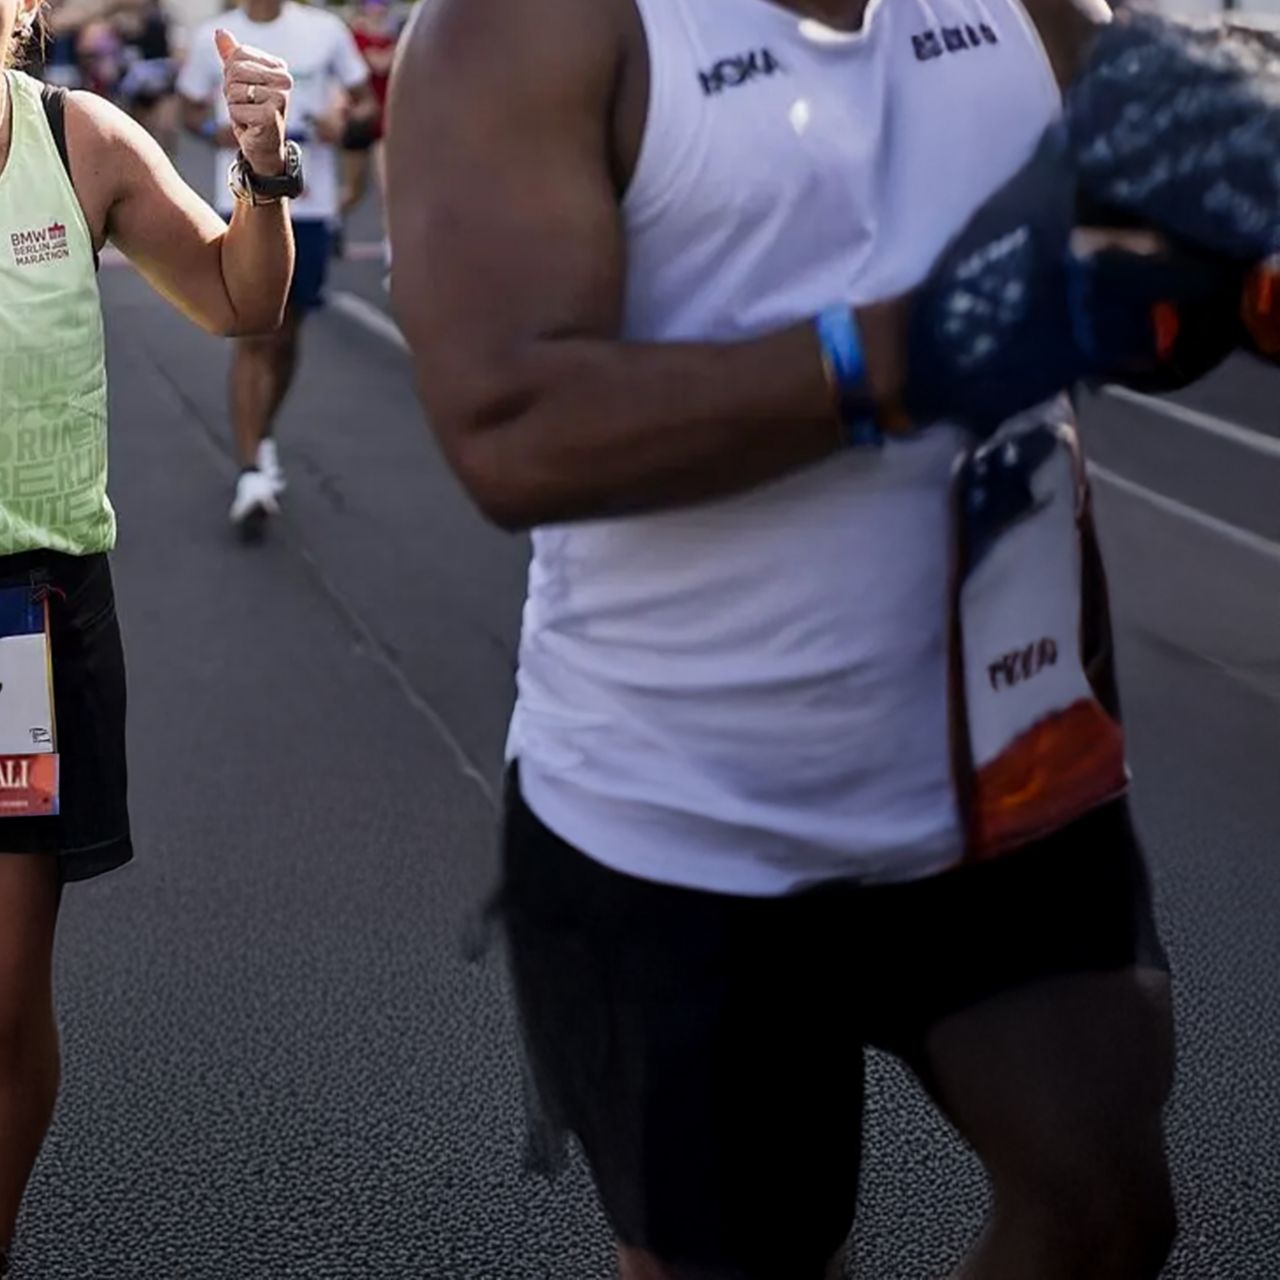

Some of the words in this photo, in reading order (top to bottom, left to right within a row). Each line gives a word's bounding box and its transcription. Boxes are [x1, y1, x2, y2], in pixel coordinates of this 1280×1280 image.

[11, 228, 46, 246] BMW
[13, 242, 50, 256] BERLIN
[15, 249, 69, 266] MARATHON
